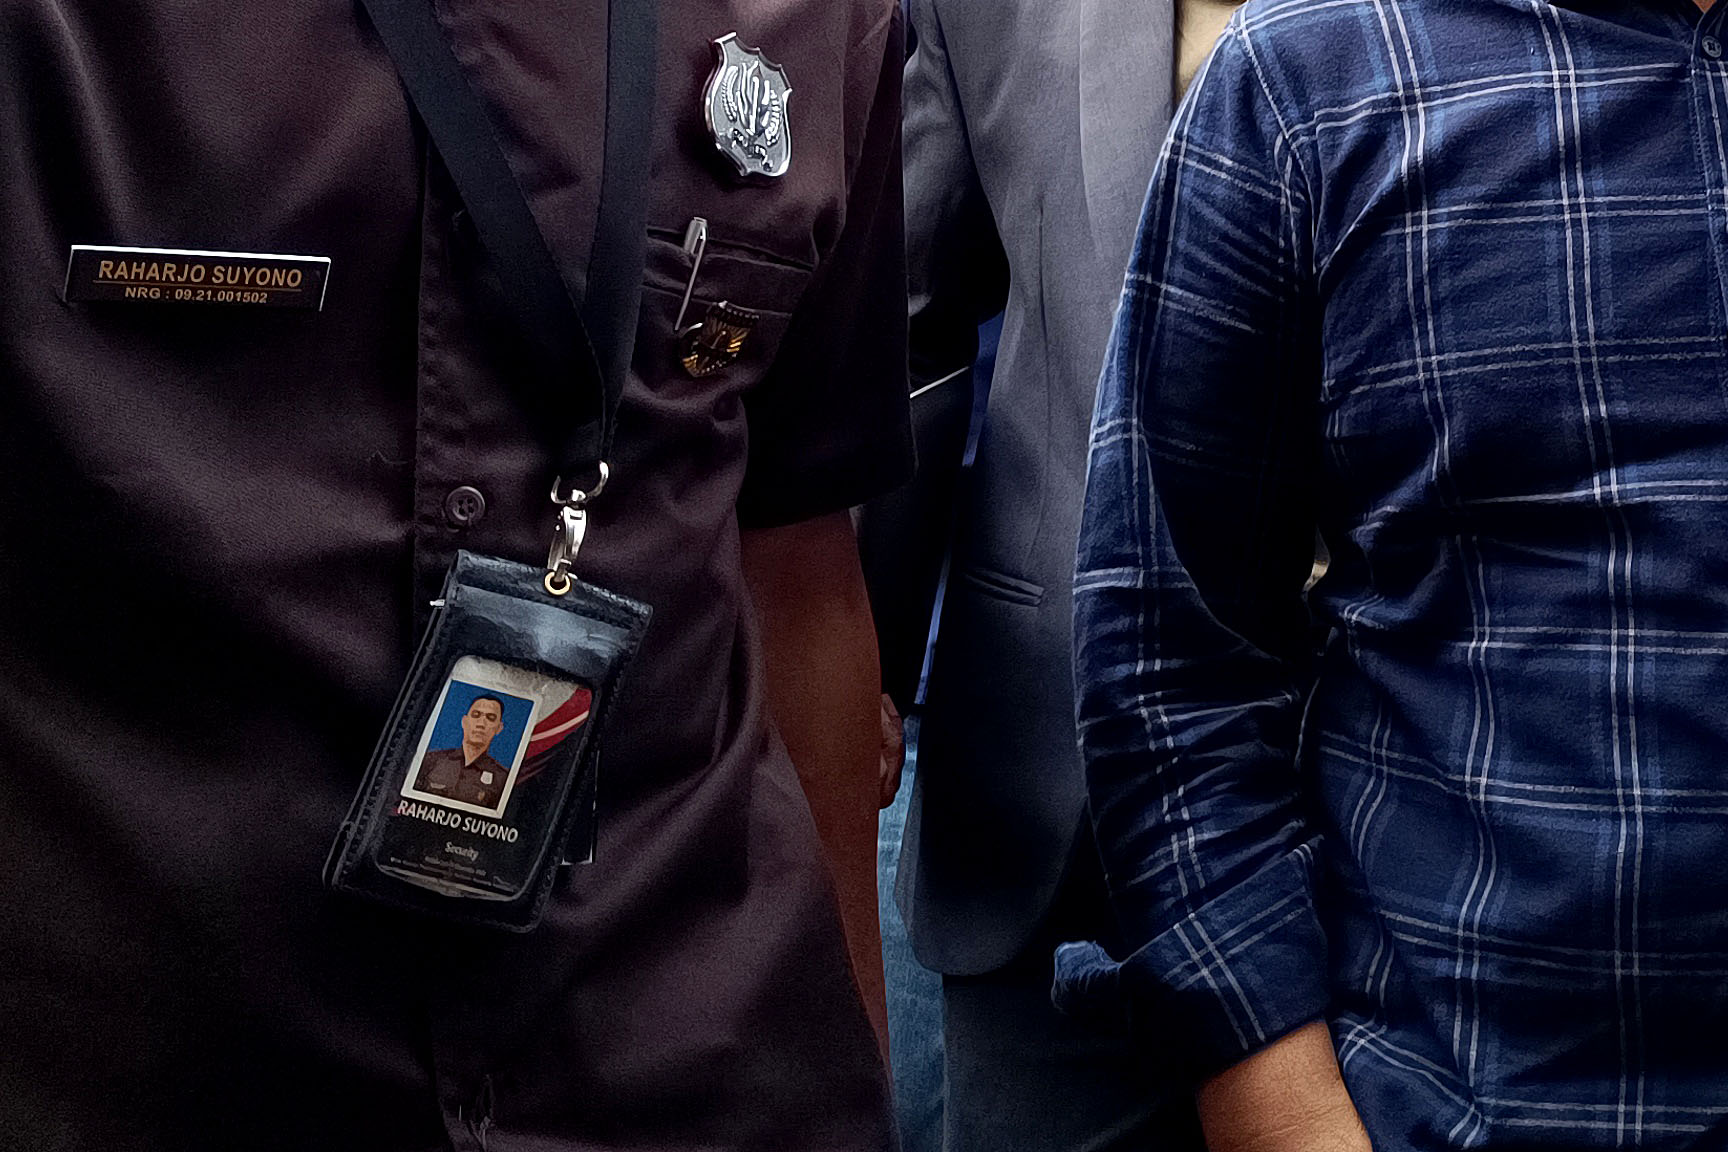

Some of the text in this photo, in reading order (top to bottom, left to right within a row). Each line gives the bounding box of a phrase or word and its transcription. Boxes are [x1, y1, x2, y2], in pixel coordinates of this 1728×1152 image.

[98, 260, 303, 288] RAHARJO SUYONO
[124, 286, 162, 299] NRG
[174, 288, 268, 304] 09.21.001502
[397, 799, 519, 843] RAHARJO SUYONO
